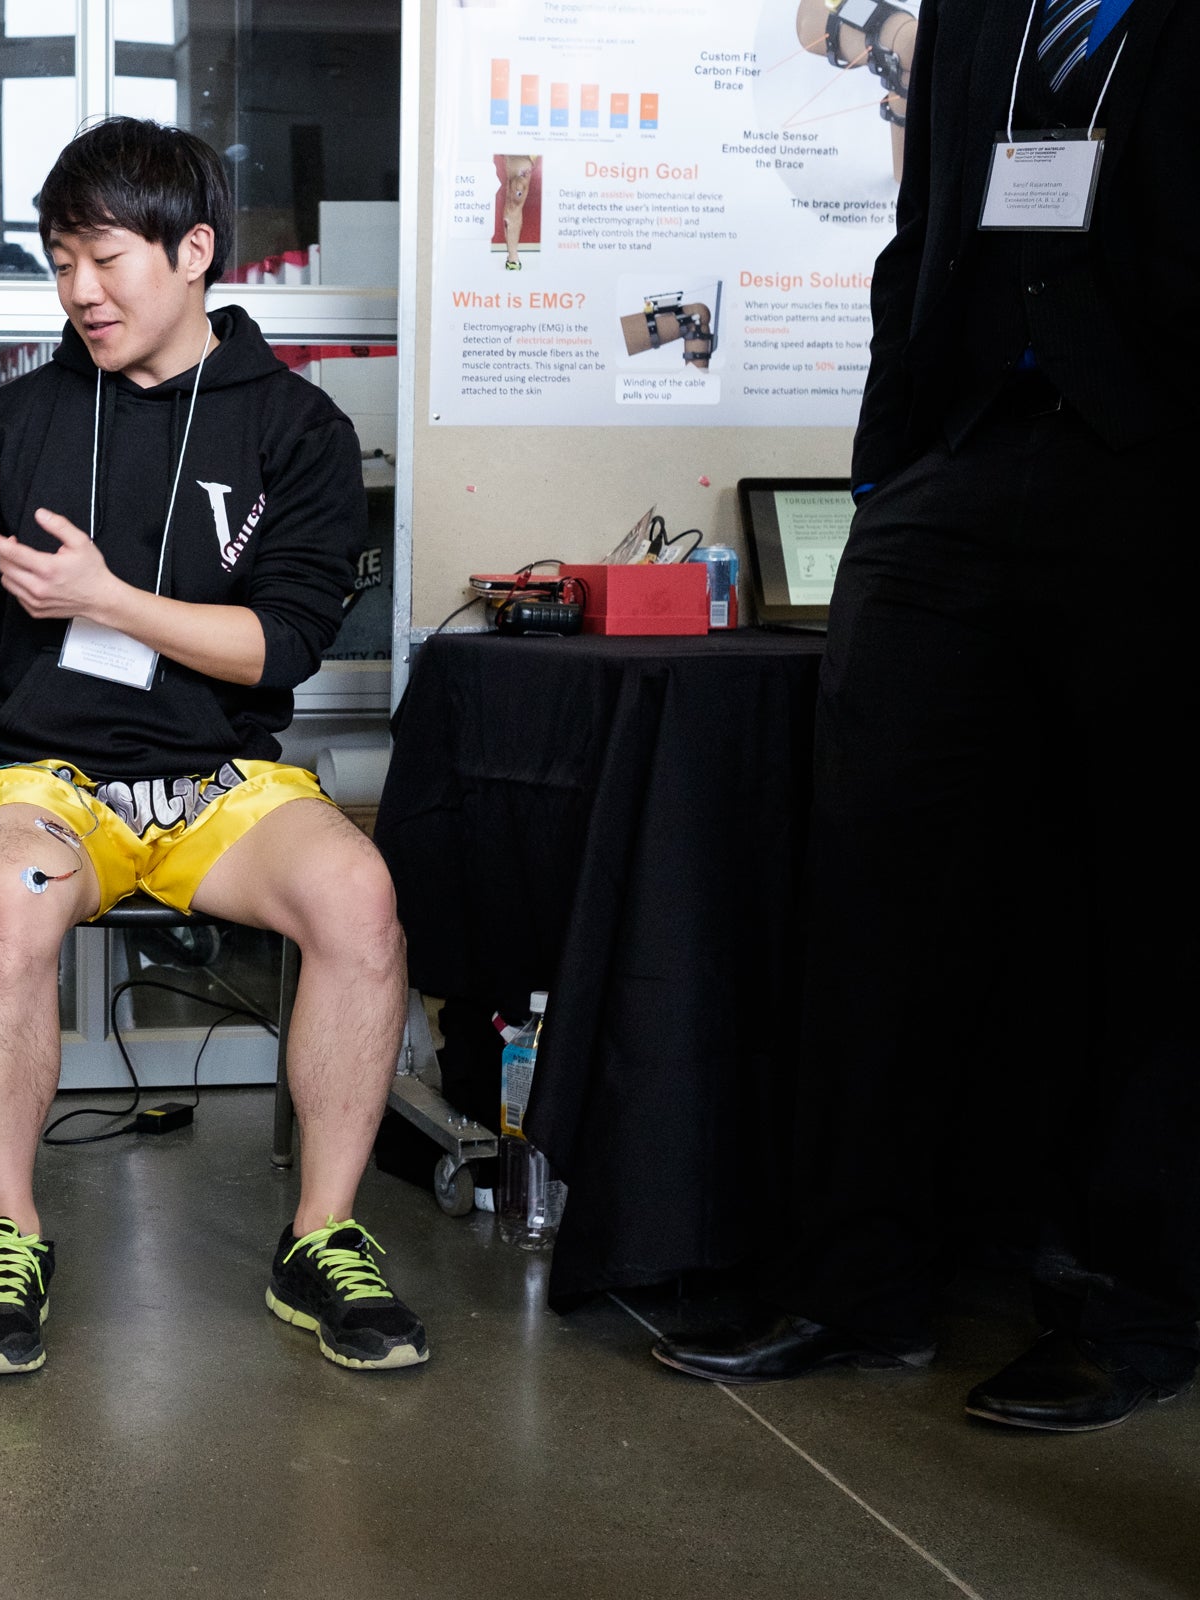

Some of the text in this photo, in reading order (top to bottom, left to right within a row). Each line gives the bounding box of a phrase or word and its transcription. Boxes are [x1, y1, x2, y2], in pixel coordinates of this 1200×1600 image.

[700, 50, 757, 62] Custom Fit
[694, 64, 762, 77] Carbon Fiber
[714, 80, 744, 91] Brace
[743, 130, 819, 142] Muscle Sensor
[722, 144, 839, 157] Embedded Underneath
[756, 159, 805, 170] the Brace
[585, 161, 699, 183] Design Goal
[455, 176, 476, 185] EMG
[454, 188, 475, 199] pads
[559, 188, 587, 200] Design
[600, 190, 635, 200] assistive
[637, 191, 695, 201] biomechanical
[697, 192, 723, 201] device
[454, 201, 491, 211] attached
[558, 202, 725, 214] that detects the user's intention to stand
[791, 198, 810, 209] The
[812, 198, 841, 209] brace
[843, 200, 887, 212] provides
[454, 214, 464, 224] to
[472, 214, 485, 226] leg
[558, 215, 700, 227] using electromyography (EMG) and
[819, 213, 830, 222] of
[832, 214, 867, 223] motion
[870, 214, 885, 223] for
[558, 228, 738, 241] adaptively controls the mechanical system to
[557, 241, 580, 250] assist
[582, 241, 596, 251] the
[618, 242, 627, 251] to
[629, 242, 652, 251] stand
[740, 270, 803, 293] Design
[452, 290, 586, 310] What is EMG?
[744, 300, 769, 310] When
[771, 302, 789, 311] your
[790, 300, 823, 310] muscles
[824, 300, 839, 310] flex
[840, 302, 850, 310] to
[744, 314, 784, 323] activation
[786, 314, 819, 323] patterns
[820, 314, 836, 323] and
[463, 322, 589, 334] Electromyography (EMG) is the
[462, 335, 593, 347] detection of electrical impulses
[744, 340, 779, 350] Standing
[780, 340, 805, 350] speed
[806, 340, 834, 350] adapts
[835, 341, 844, 349] to
[845, 340, 863, 349] how
[462, 348, 600, 359] generated by muscle fibers as the
[462, 361, 606, 373] muscle contracts. This signal can be
[743, 362, 759, 371] Can
[760, 362, 791, 372] provide
[792, 363, 804, 373] up
[804, 362, 814, 371] to
[462, 374, 572, 385] measured using electrodes
[623, 378, 706, 390] Winding of the cable
[461, 386, 543, 397] attached to the skin
[622, 390, 673, 402] pulls you up
[743, 386, 770, 396] Device
[771, 386, 809, 396] actuation
[810, 386, 839, 396] mimics
